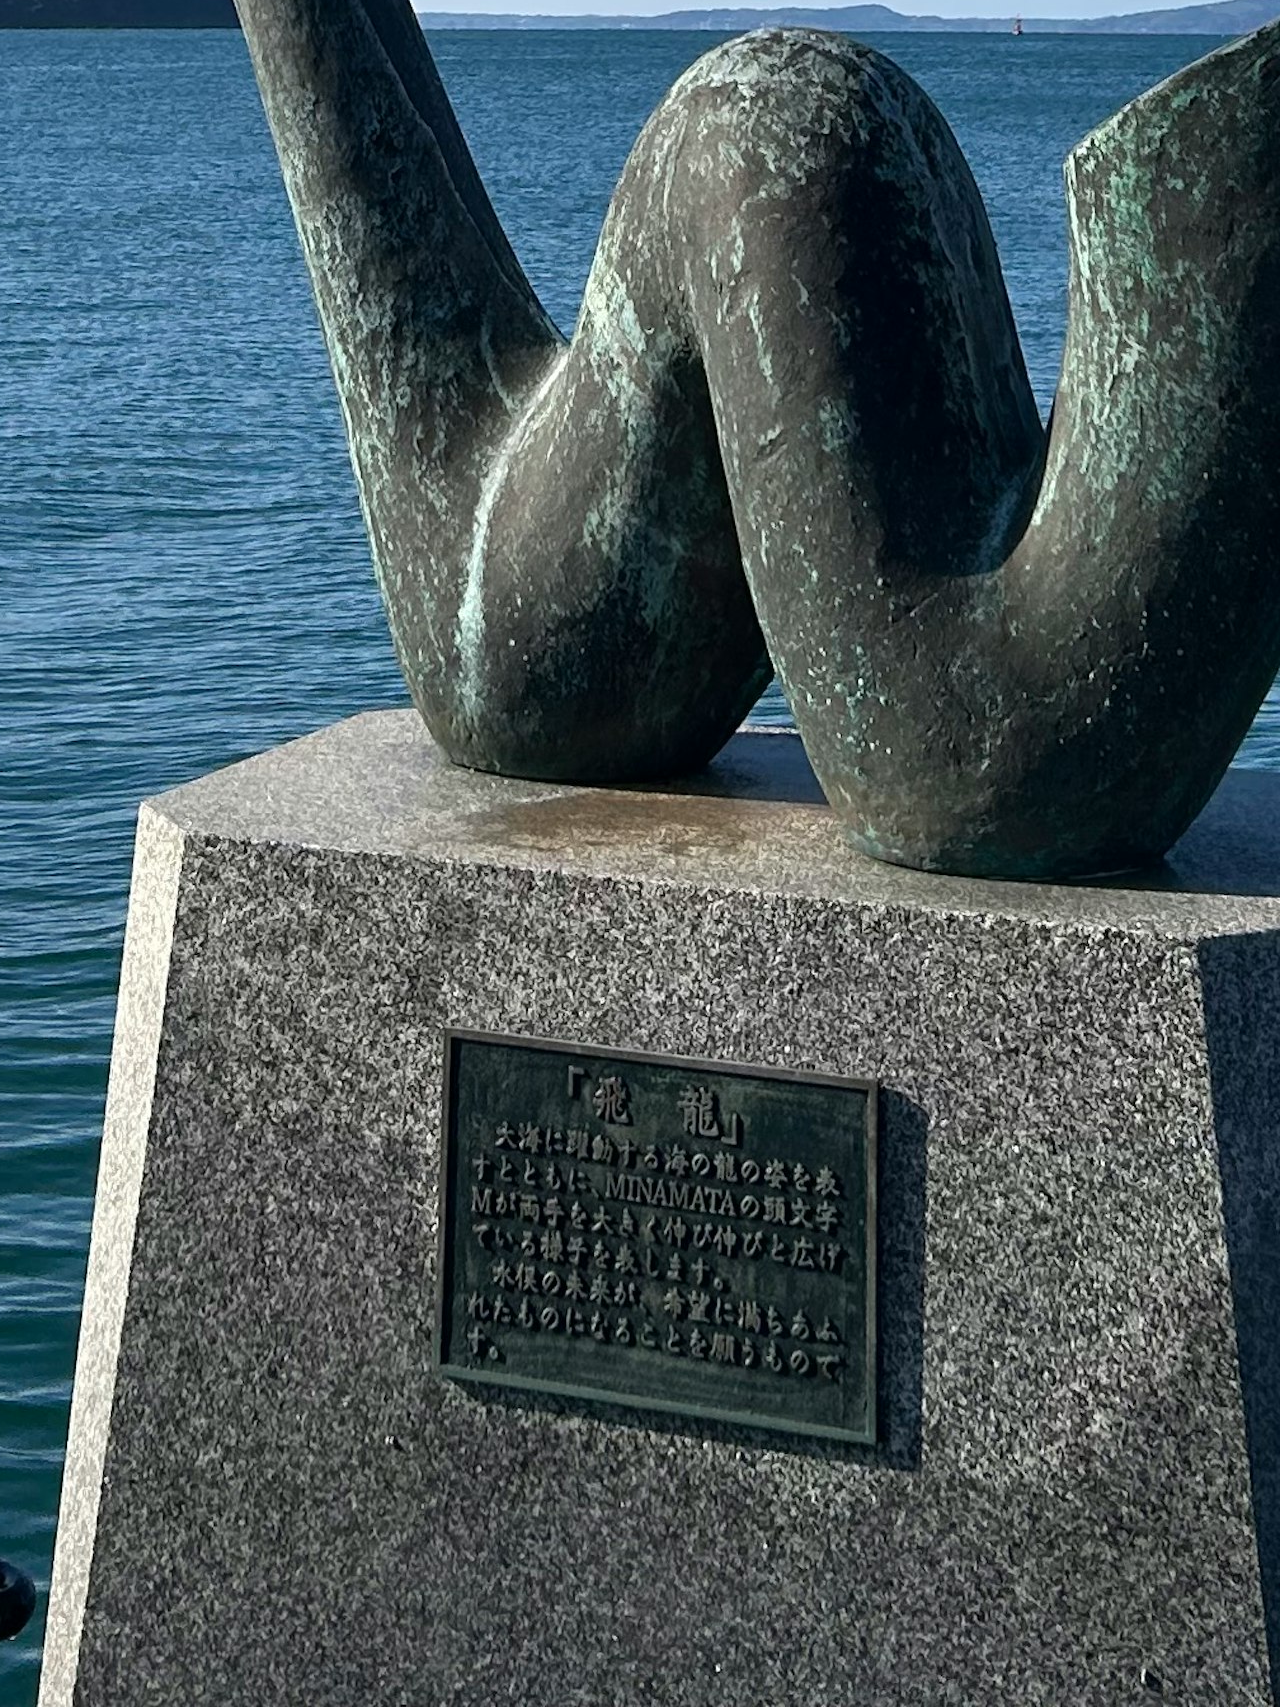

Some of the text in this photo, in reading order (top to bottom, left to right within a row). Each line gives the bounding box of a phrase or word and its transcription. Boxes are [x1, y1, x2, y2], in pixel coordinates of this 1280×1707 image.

[471, 1223, 724, 1291] ている様子を表します。
[466, 1325, 499, 1361] す。
